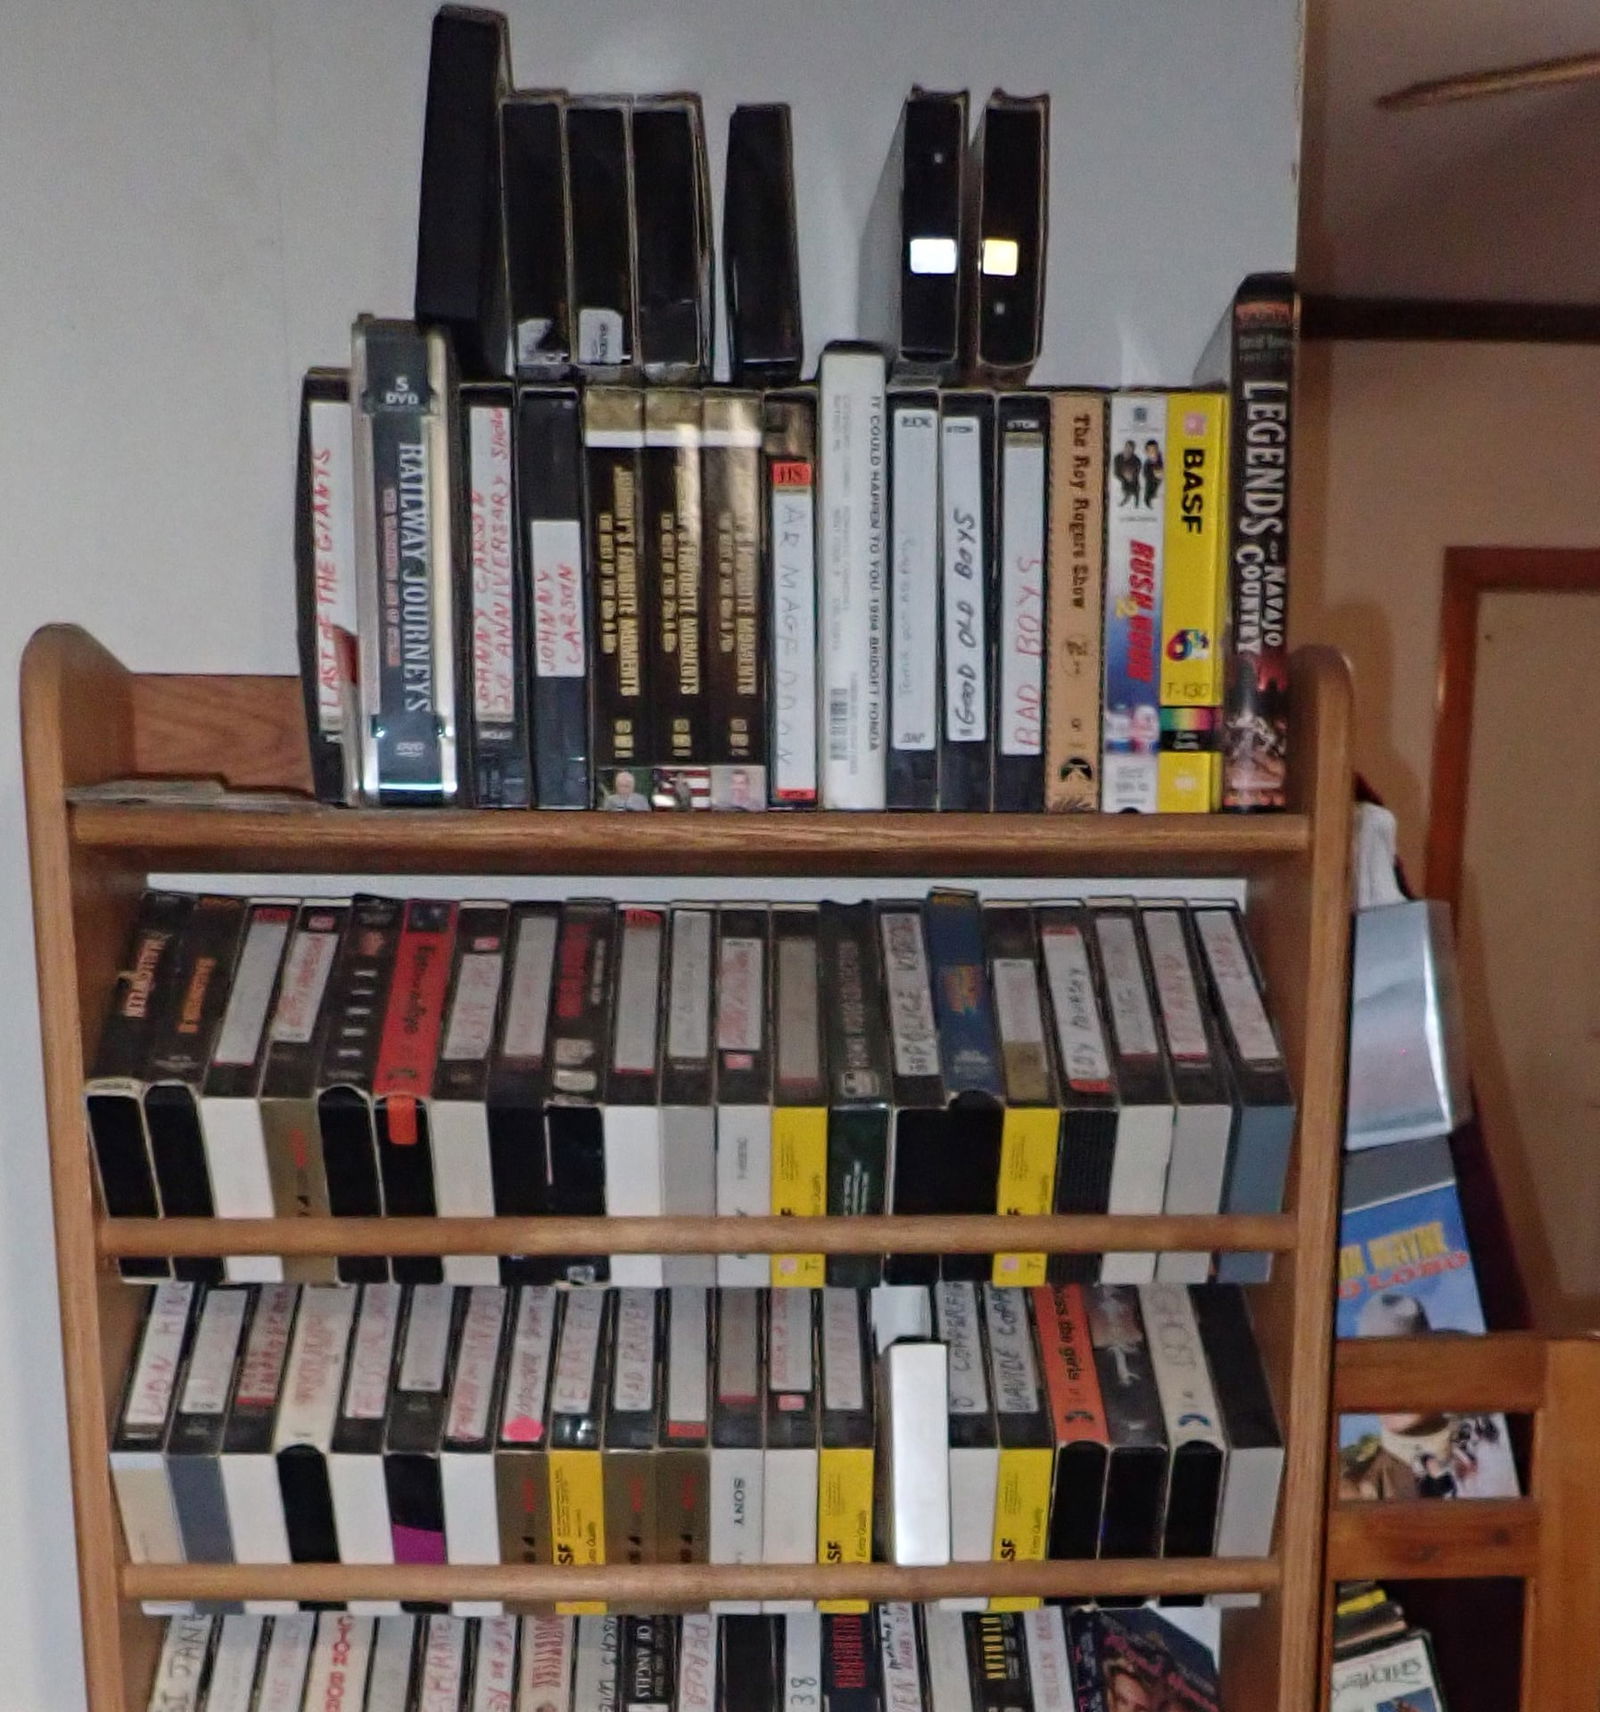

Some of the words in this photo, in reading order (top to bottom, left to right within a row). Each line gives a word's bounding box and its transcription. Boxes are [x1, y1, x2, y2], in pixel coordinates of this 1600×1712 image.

[868, 415, 881, 466] COULD
[1072, 414, 1091, 448] The
[1239, 380, 1290, 537] LEGENDS
[399, 442, 427, 562] RAILWAY
[867, 470, 881, 530] HAPPEN
[1069, 454, 1090, 490] Roy
[1180, 448, 1206, 535] BASF
[867, 534, 880, 554] TO
[953, 507, 975, 580] BOYS
[1070, 496, 1090, 560] Rogers
[316, 565, 338, 607] THE
[867, 560, 880, 591] YOU
[1014, 554, 1041, 657] BOYS
[1071, 563, 1090, 611] Show
[1128, 540, 1156, 610] RUSH
[1236, 544, 1265, 654] COUNTRY
[1263, 565, 1286, 647] NAVAJO
[401, 567, 431, 713] JOURNEYS
[954, 600, 976, 649] OLD
[1014, 683, 1041, 746] BAD
[732, 1477, 746, 1528] SONY
